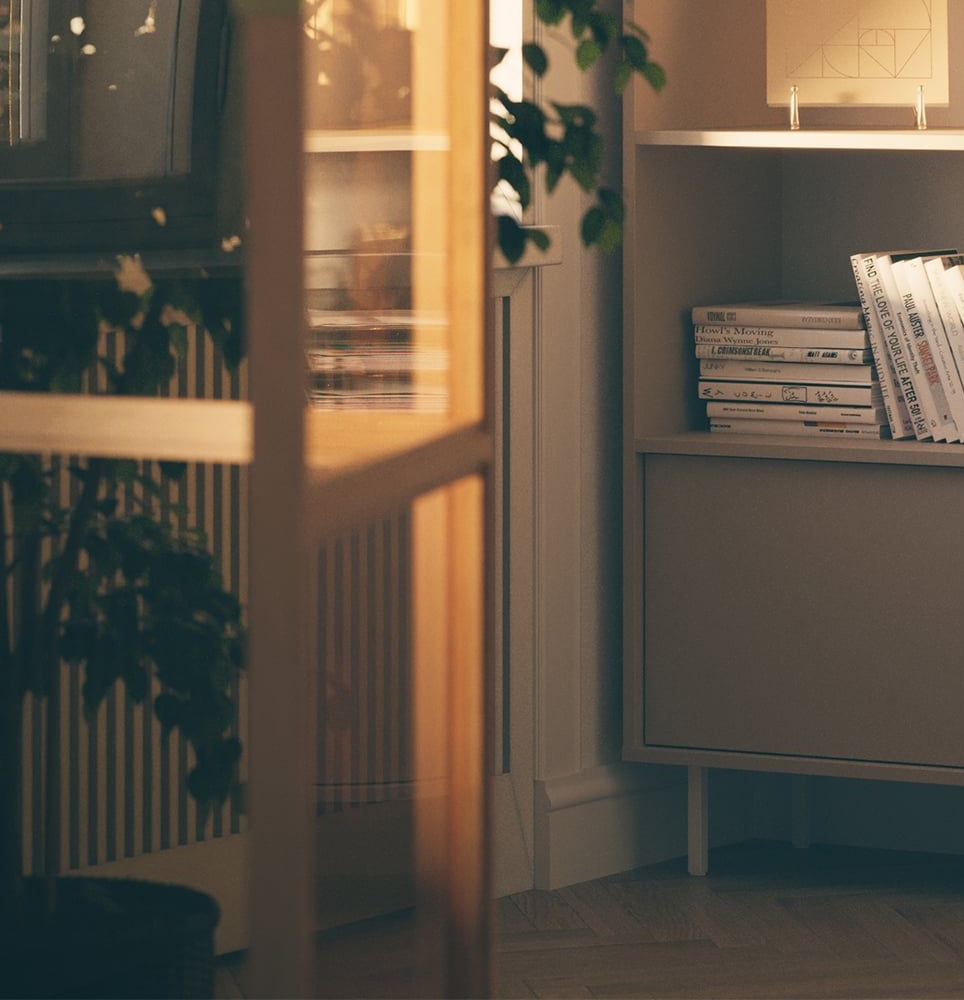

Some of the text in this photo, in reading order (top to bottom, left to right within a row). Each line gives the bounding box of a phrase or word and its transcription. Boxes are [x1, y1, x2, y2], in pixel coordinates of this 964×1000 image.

[904, 293, 915, 312] PAUL
[695, 326, 774, 337] Howl's Moving
[909, 311, 923, 338] AUSTER
[695, 336, 721, 344] Diana
[722, 337, 754, 345] Wynne
[864, 259, 921, 416] FIND THE LOVE OF YOUR LIFE AFTER 50!
[806, 351, 821, 359] MATT
